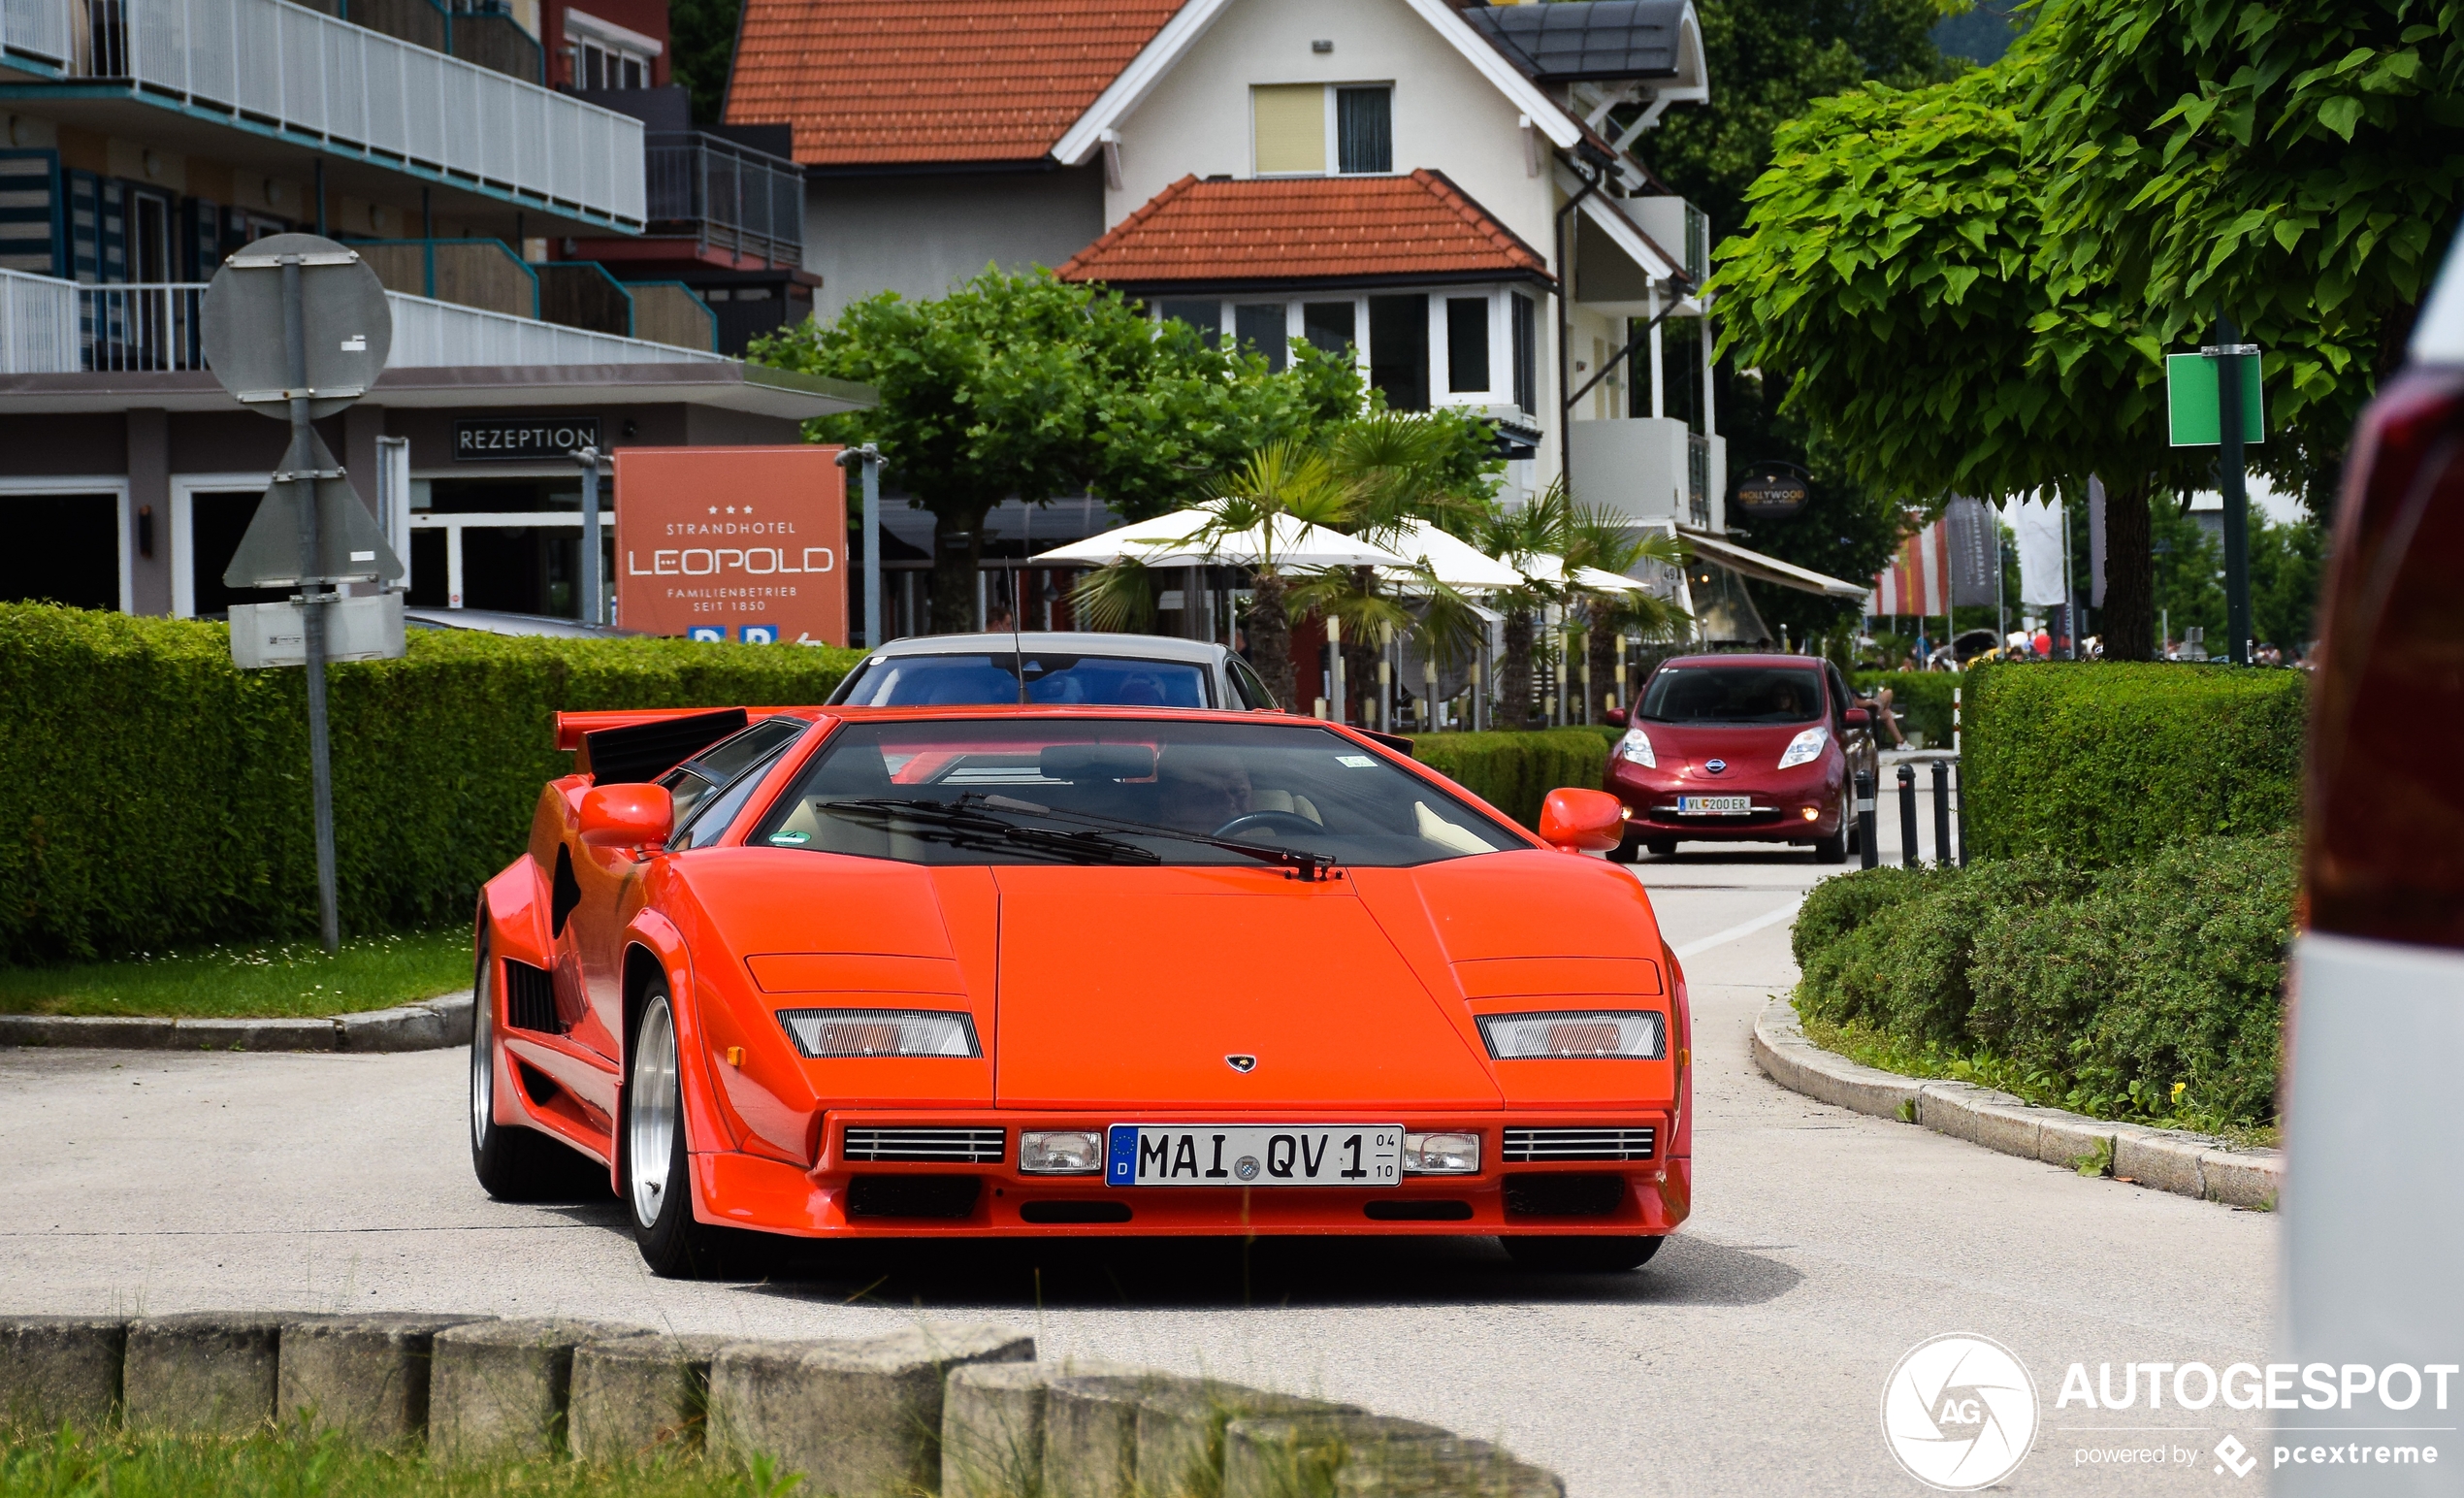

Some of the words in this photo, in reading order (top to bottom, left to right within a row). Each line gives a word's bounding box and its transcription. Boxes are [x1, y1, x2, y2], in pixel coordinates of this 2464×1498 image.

[460, 428, 595, 449] REZEPTION
[1738, 489, 1805, 500] HOLLYWOOD
[666, 522, 795, 536] STRANDHOTEL
[628, 547, 834, 575] LEOPOLD
[667, 587, 797, 598] FAMILIENBETRIEB
[694, 602, 723, 611] SEIT
[731, 601, 765, 611] 1850
[1689, 798, 1701, 810] VL
[1709, 798, 1730, 810] 200
[1733, 798, 1746, 810] ER
[1376, 1134, 1395, 1147] 04
[1138, 1134, 1228, 1178] MAI
[1267, 1134, 1329, 1178] QV
[1341, 1134, 1368, 1179] 1
[1117, 1162, 1128, 1175] D
[1376, 1164, 1394, 1178] 10
